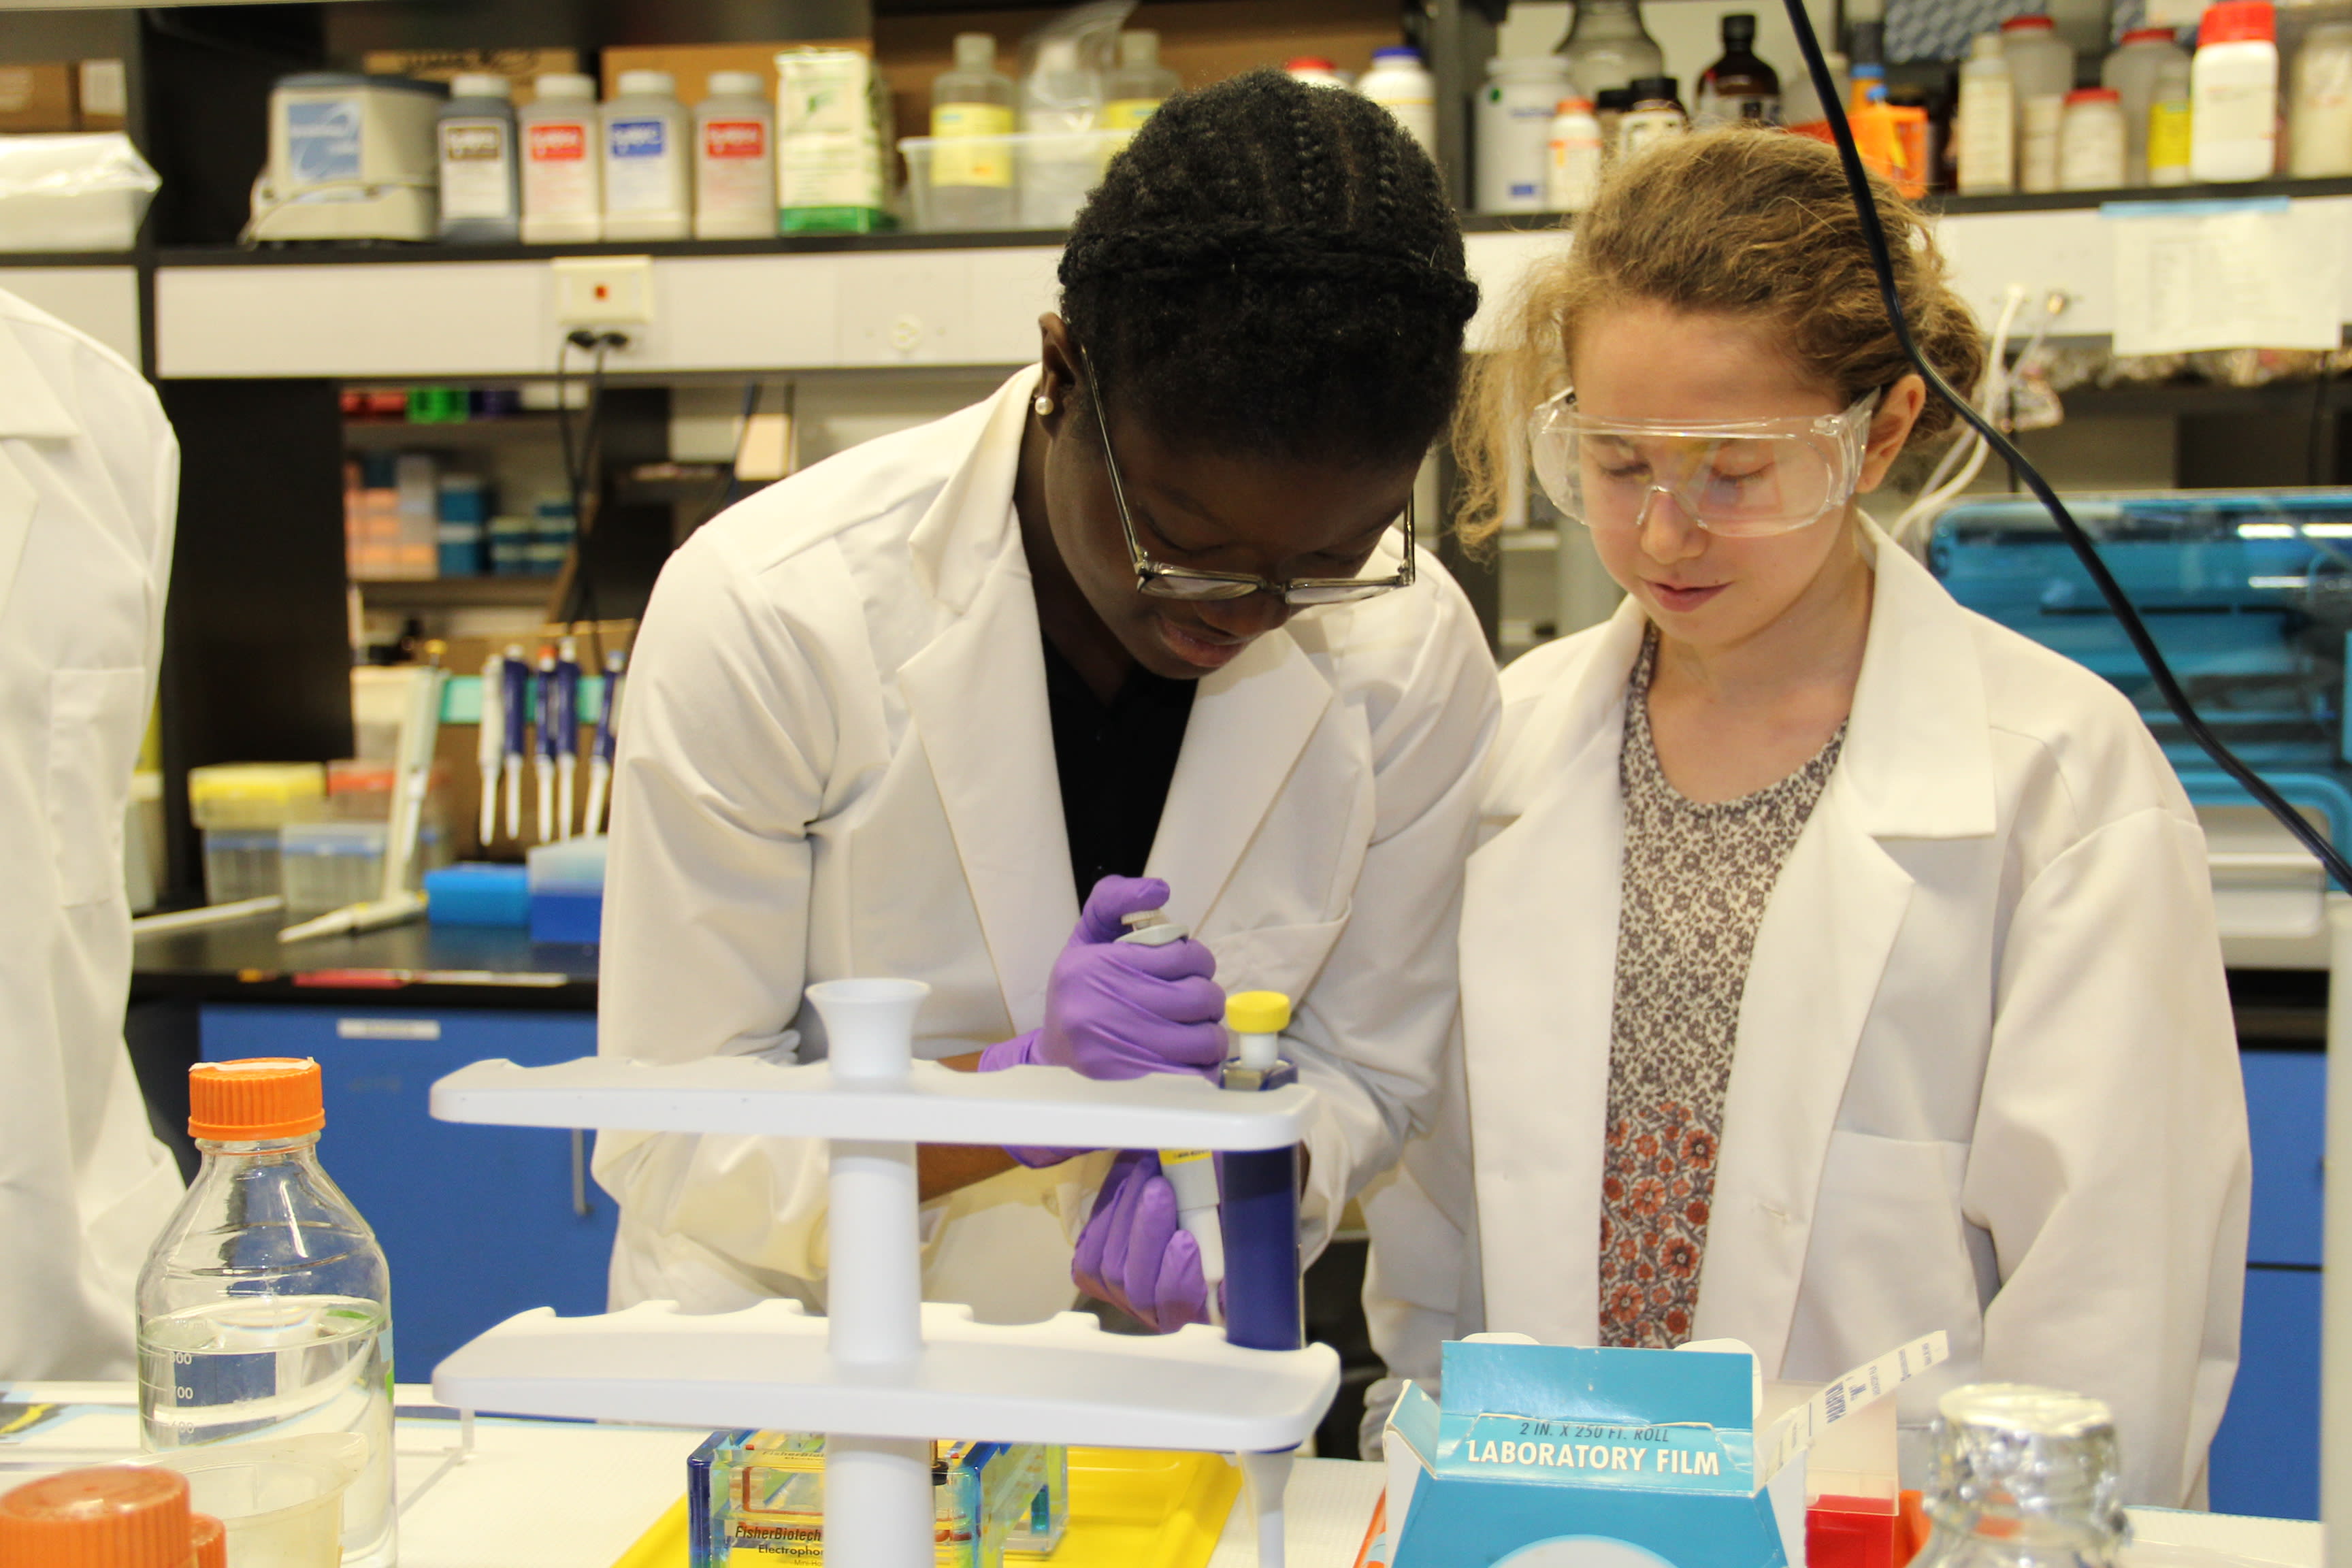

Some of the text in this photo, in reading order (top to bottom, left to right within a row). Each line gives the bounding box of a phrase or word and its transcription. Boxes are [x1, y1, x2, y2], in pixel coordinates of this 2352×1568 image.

[170, 1352, 192, 1365] 800
[1519, 1422, 1529, 1435] 2
[1534, 1423, 1553, 1436] IN.
[1559, 1424, 1569, 1437] X
[1575, 1426, 1603, 1439] 250
[1633, 1428, 1669, 1442] ROLL
[1467, 1439, 1720, 1476] LABORATORY FILM
[735, 1525, 821, 1541] FisherBiotech
